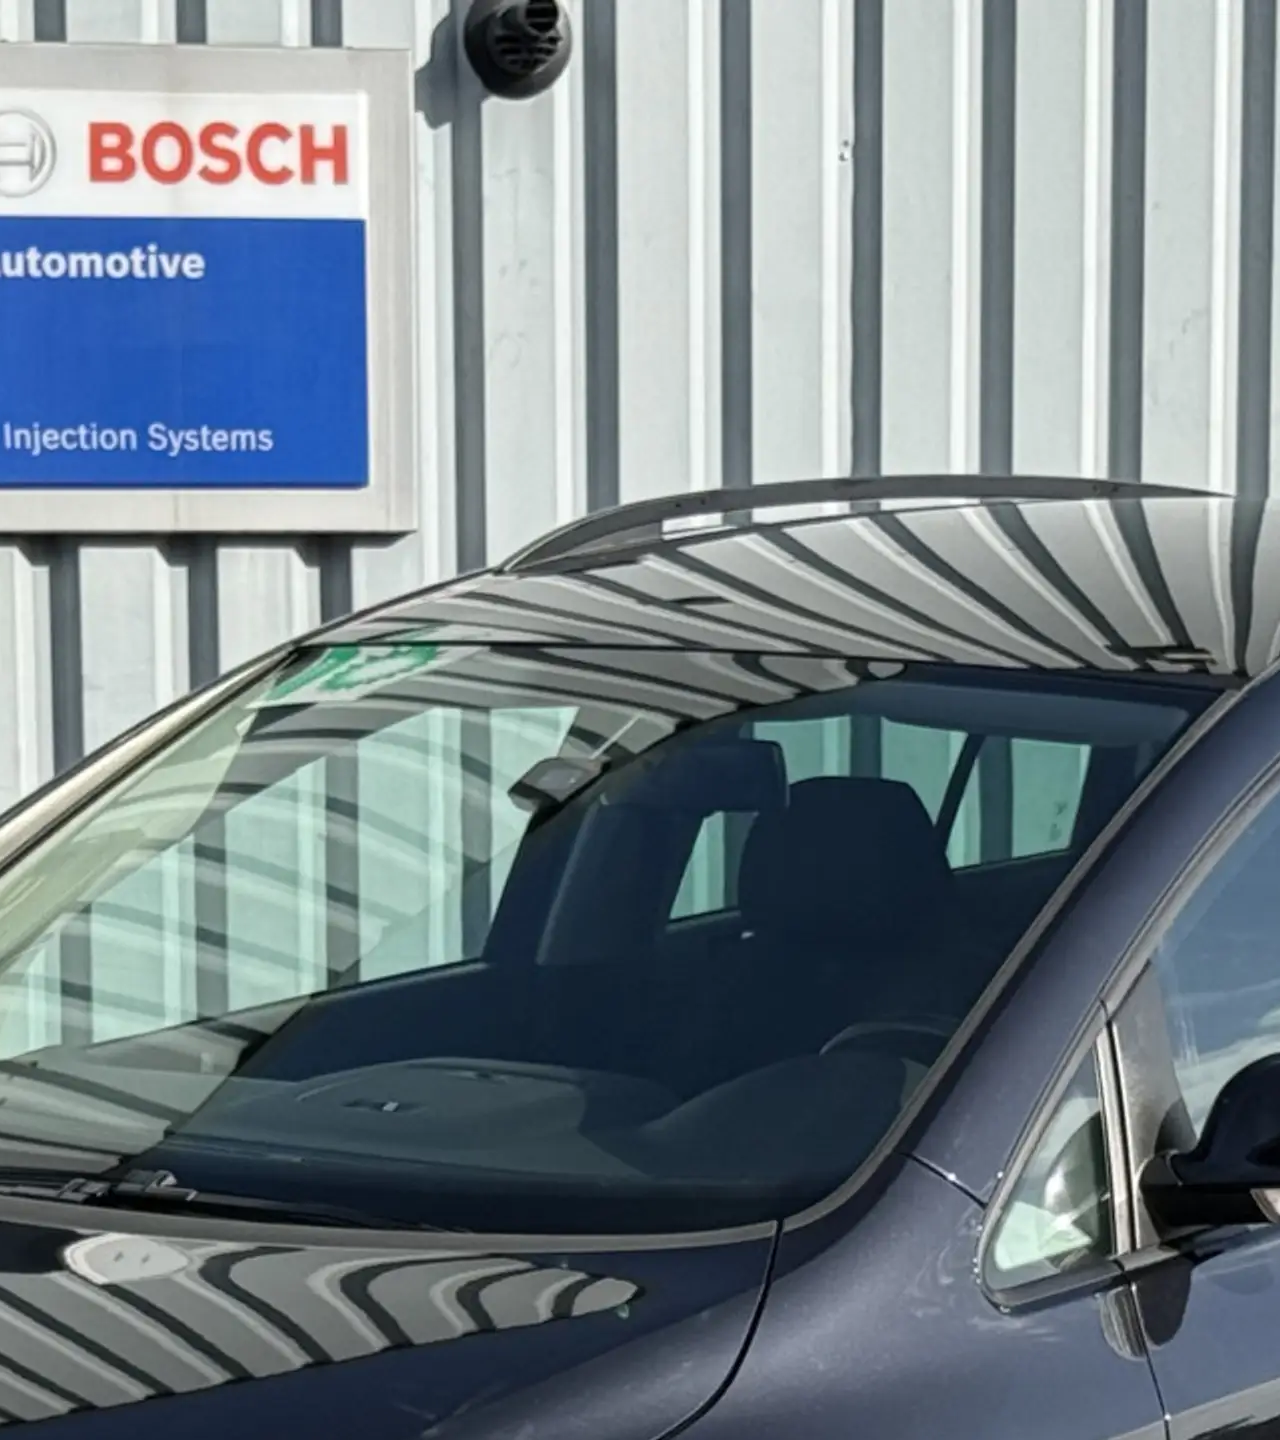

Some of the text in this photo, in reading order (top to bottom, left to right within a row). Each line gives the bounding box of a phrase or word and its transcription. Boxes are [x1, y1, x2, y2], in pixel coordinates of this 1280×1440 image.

[88, 121, 349, 185] BOSCH
[3, 421, 274, 457] Injection Systems
